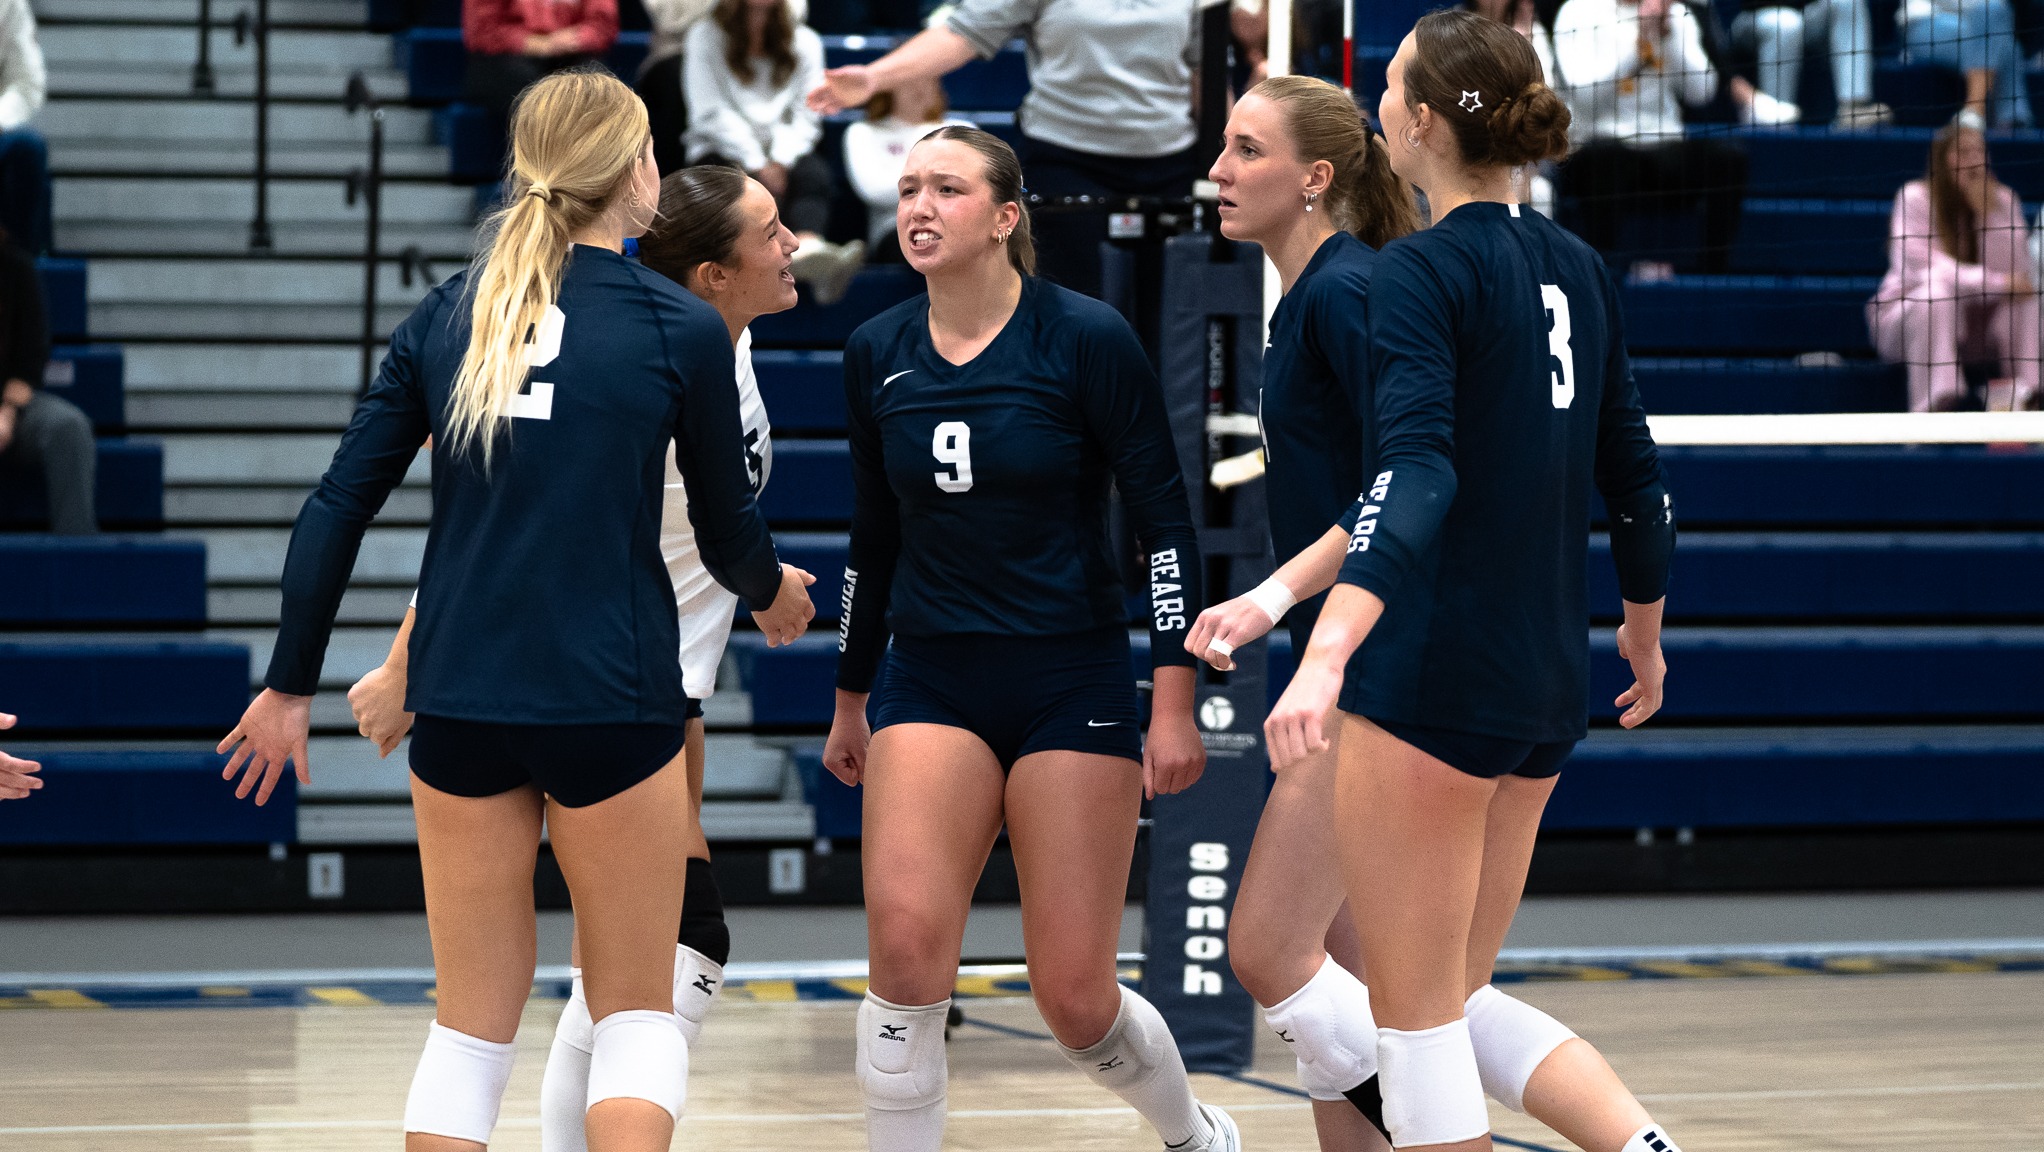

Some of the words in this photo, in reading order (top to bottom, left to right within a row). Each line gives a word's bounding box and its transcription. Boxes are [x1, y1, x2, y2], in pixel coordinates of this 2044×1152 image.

[498, 303, 566, 420] 2
[1540, 284, 1575, 409] 3
[932, 421, 974, 493] 9
[1151, 548, 1186, 631] BEARS
